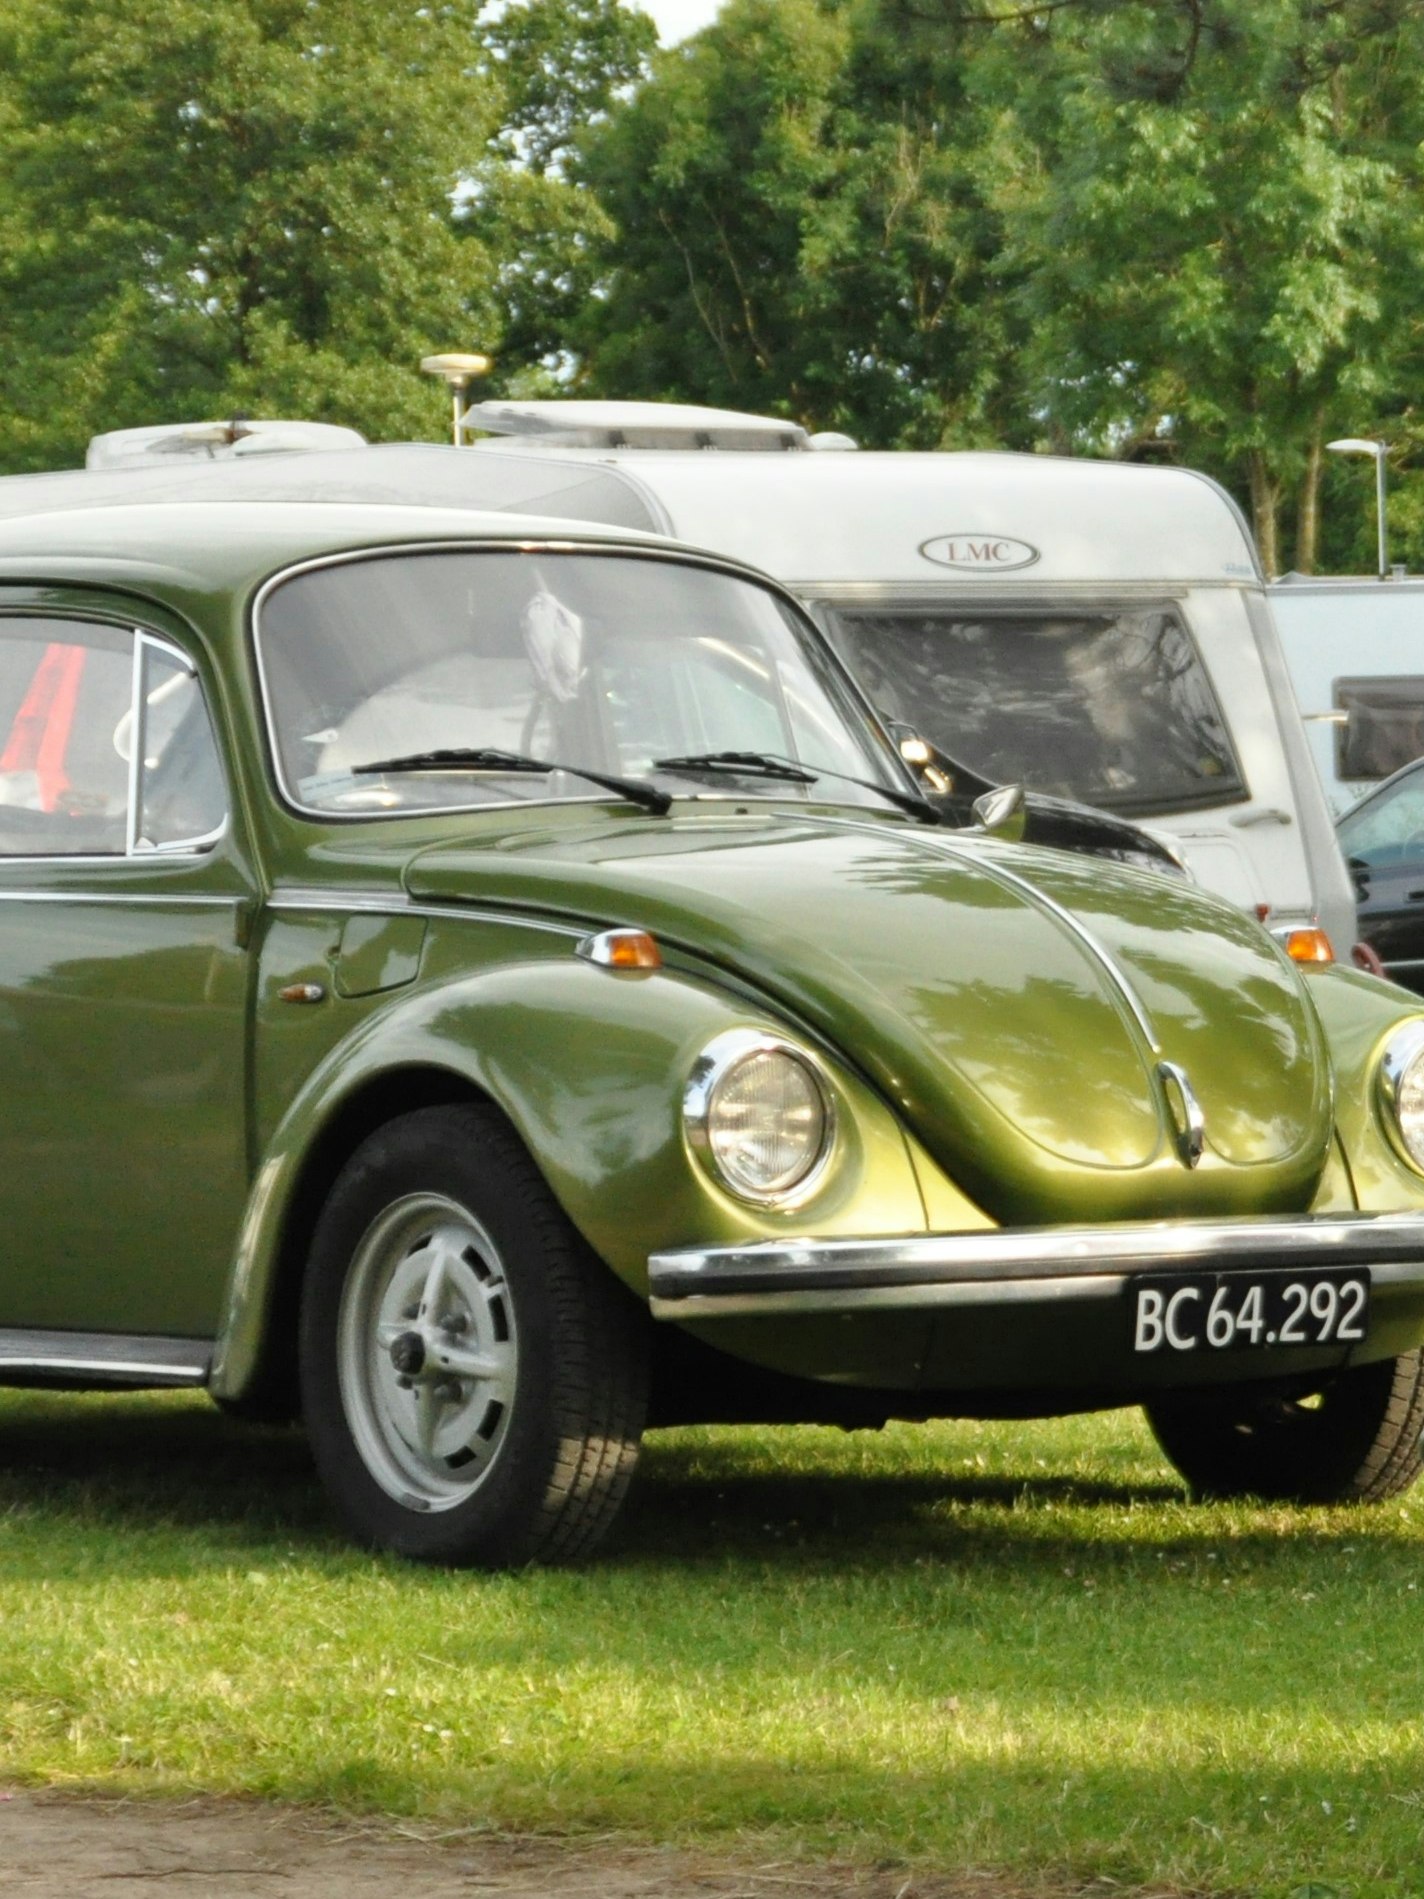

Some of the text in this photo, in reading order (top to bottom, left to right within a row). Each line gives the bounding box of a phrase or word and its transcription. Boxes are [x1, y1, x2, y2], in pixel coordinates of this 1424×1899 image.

[948, 542, 1010, 562] LMC
[1134, 1280, 1365, 1351] BC 64.292
